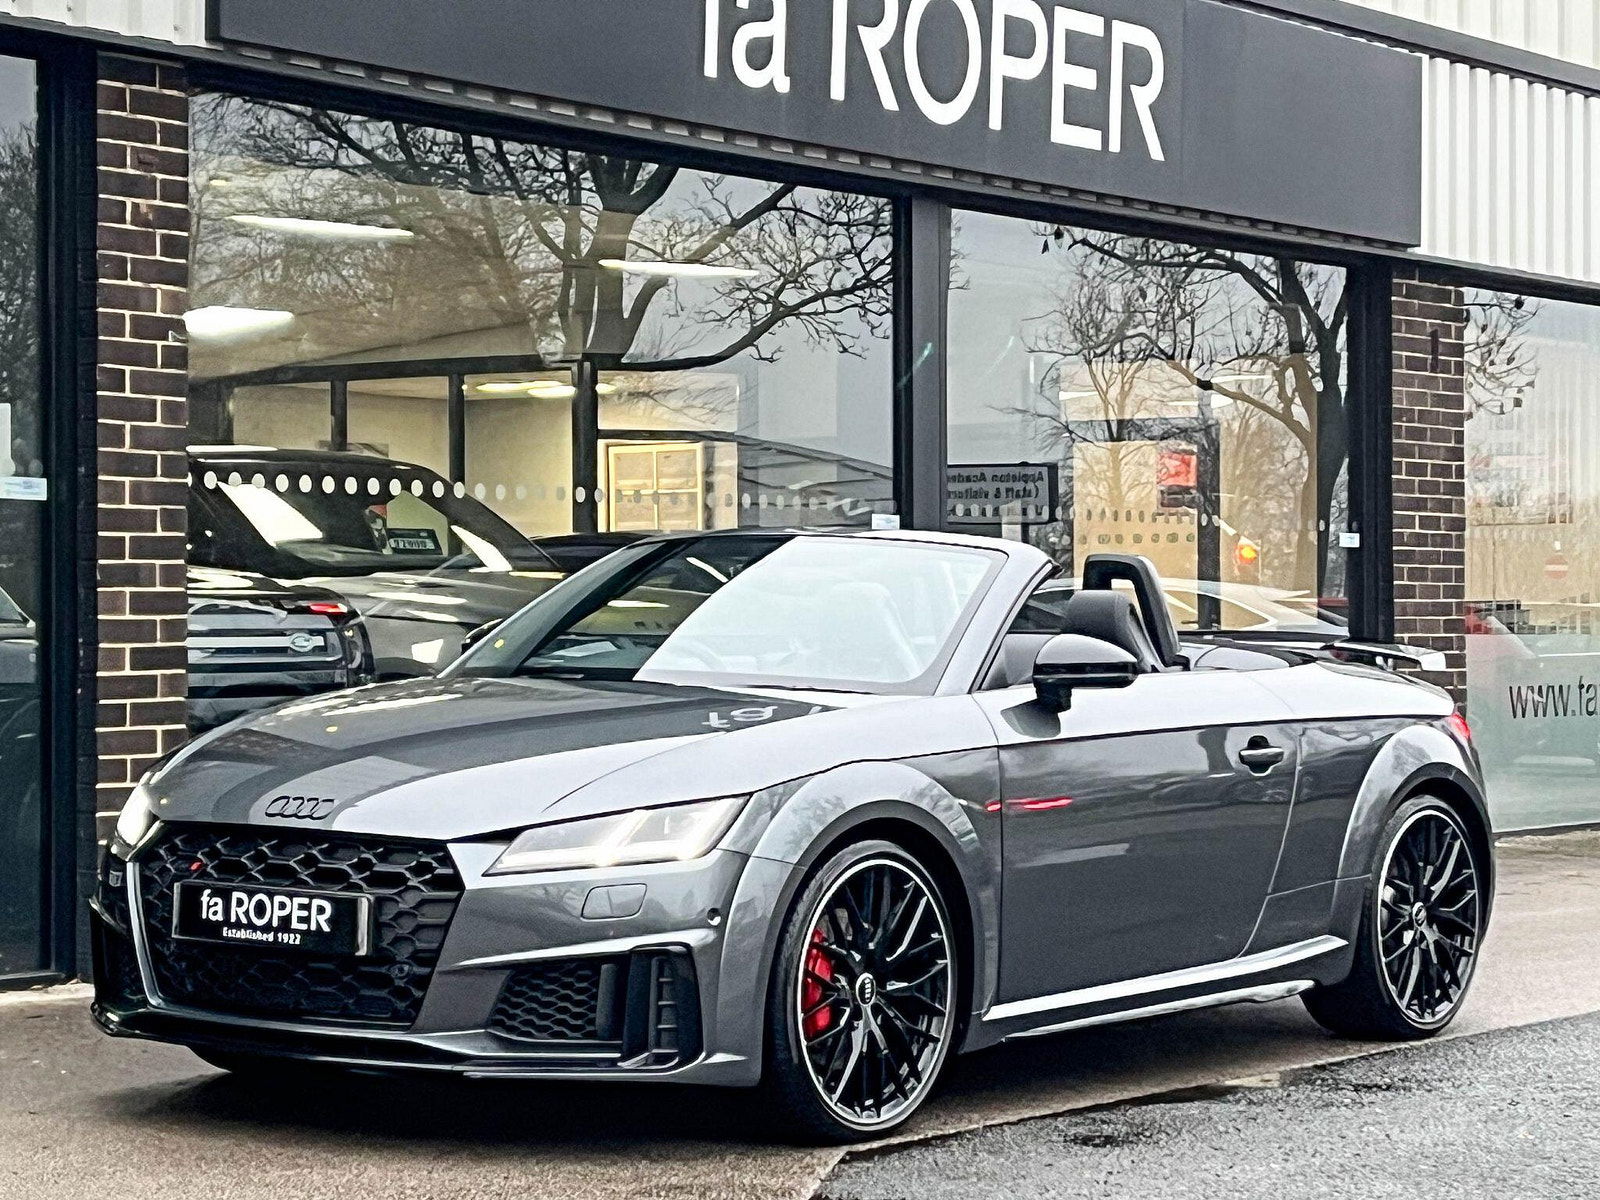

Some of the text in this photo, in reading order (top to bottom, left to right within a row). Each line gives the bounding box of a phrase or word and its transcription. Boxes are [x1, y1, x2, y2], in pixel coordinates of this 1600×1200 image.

[829, 0, 1165, 162] ROPER
[200, 888, 333, 933] fa ROPER
[222, 926, 275, 942] Established
